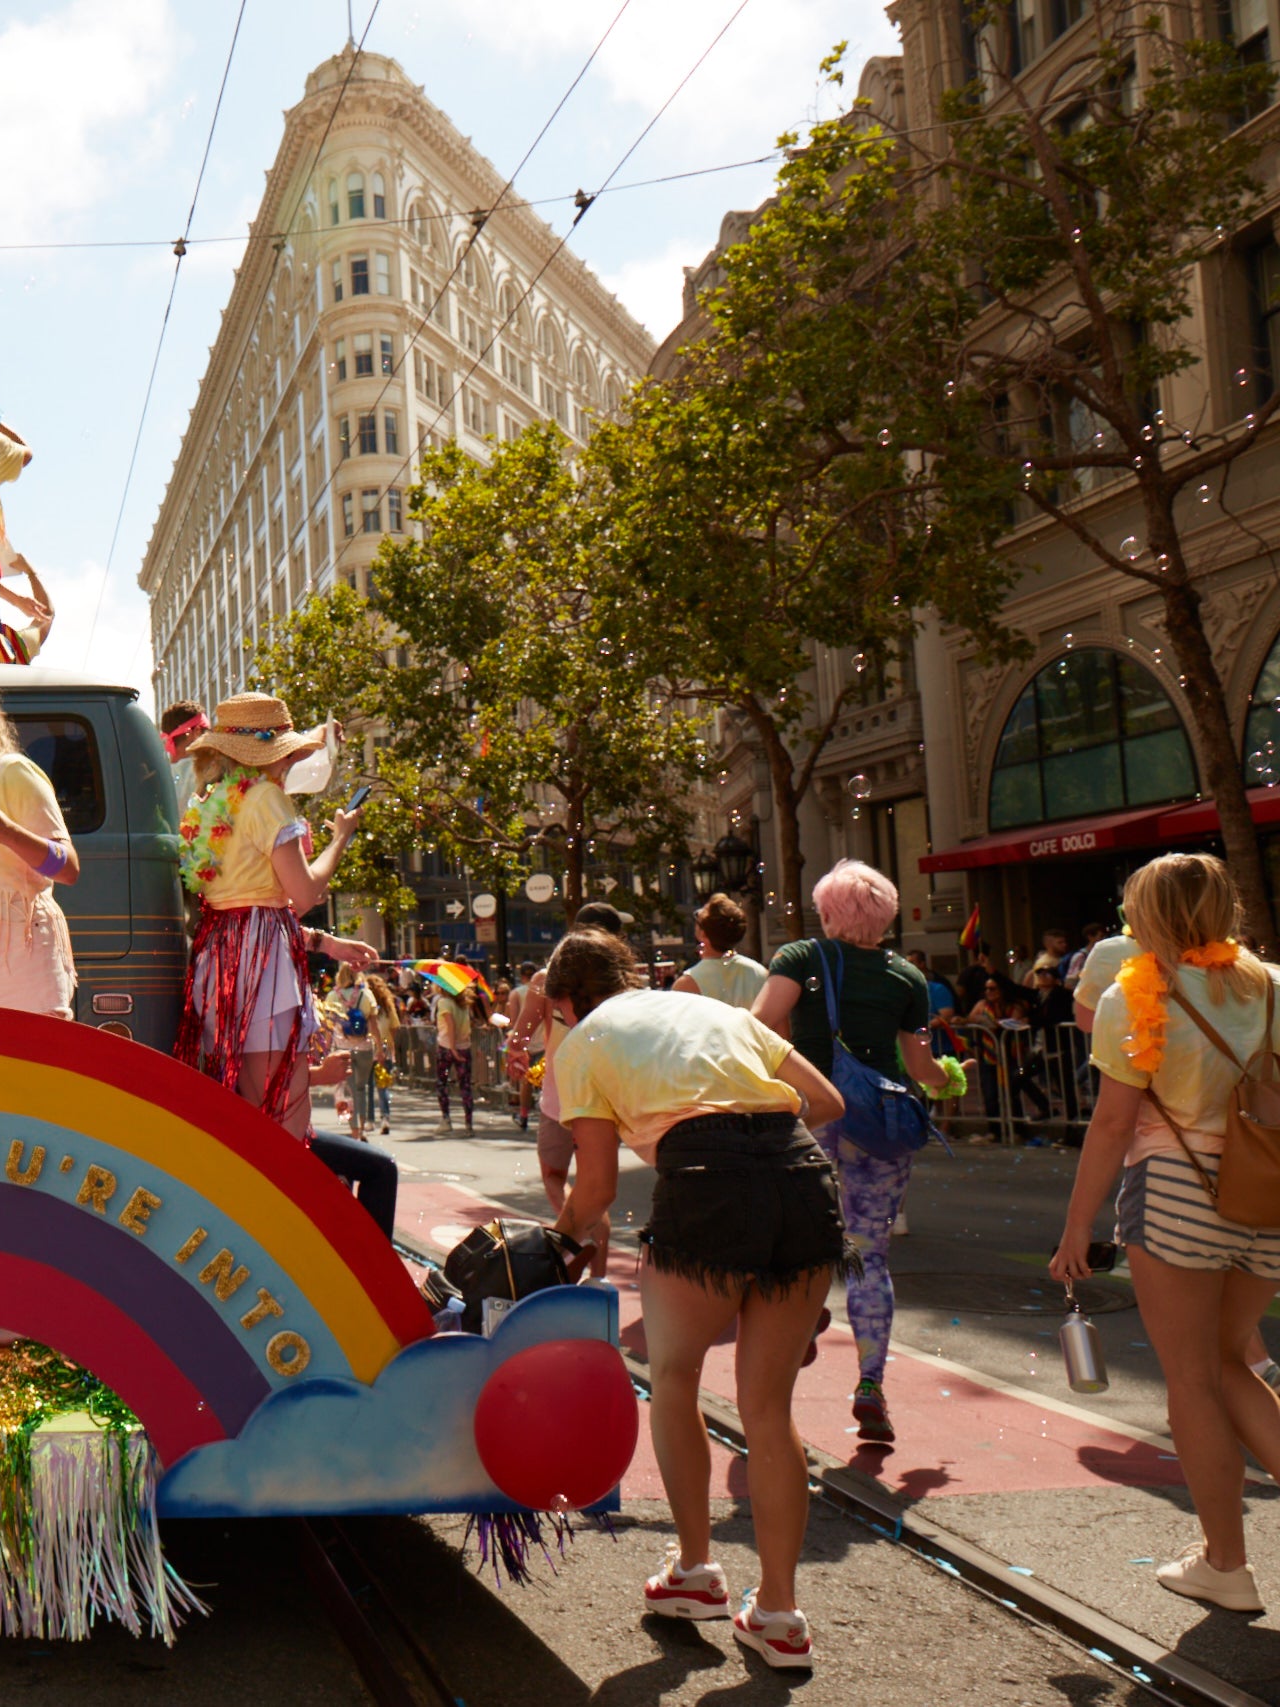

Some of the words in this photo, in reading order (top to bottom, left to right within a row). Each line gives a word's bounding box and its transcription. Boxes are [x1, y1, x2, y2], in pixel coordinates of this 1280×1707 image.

[1029, 839, 1059, 857] CAFE
[1061, 832, 1097, 852] DOLCI
[173, 1226, 312, 1378] INTO
